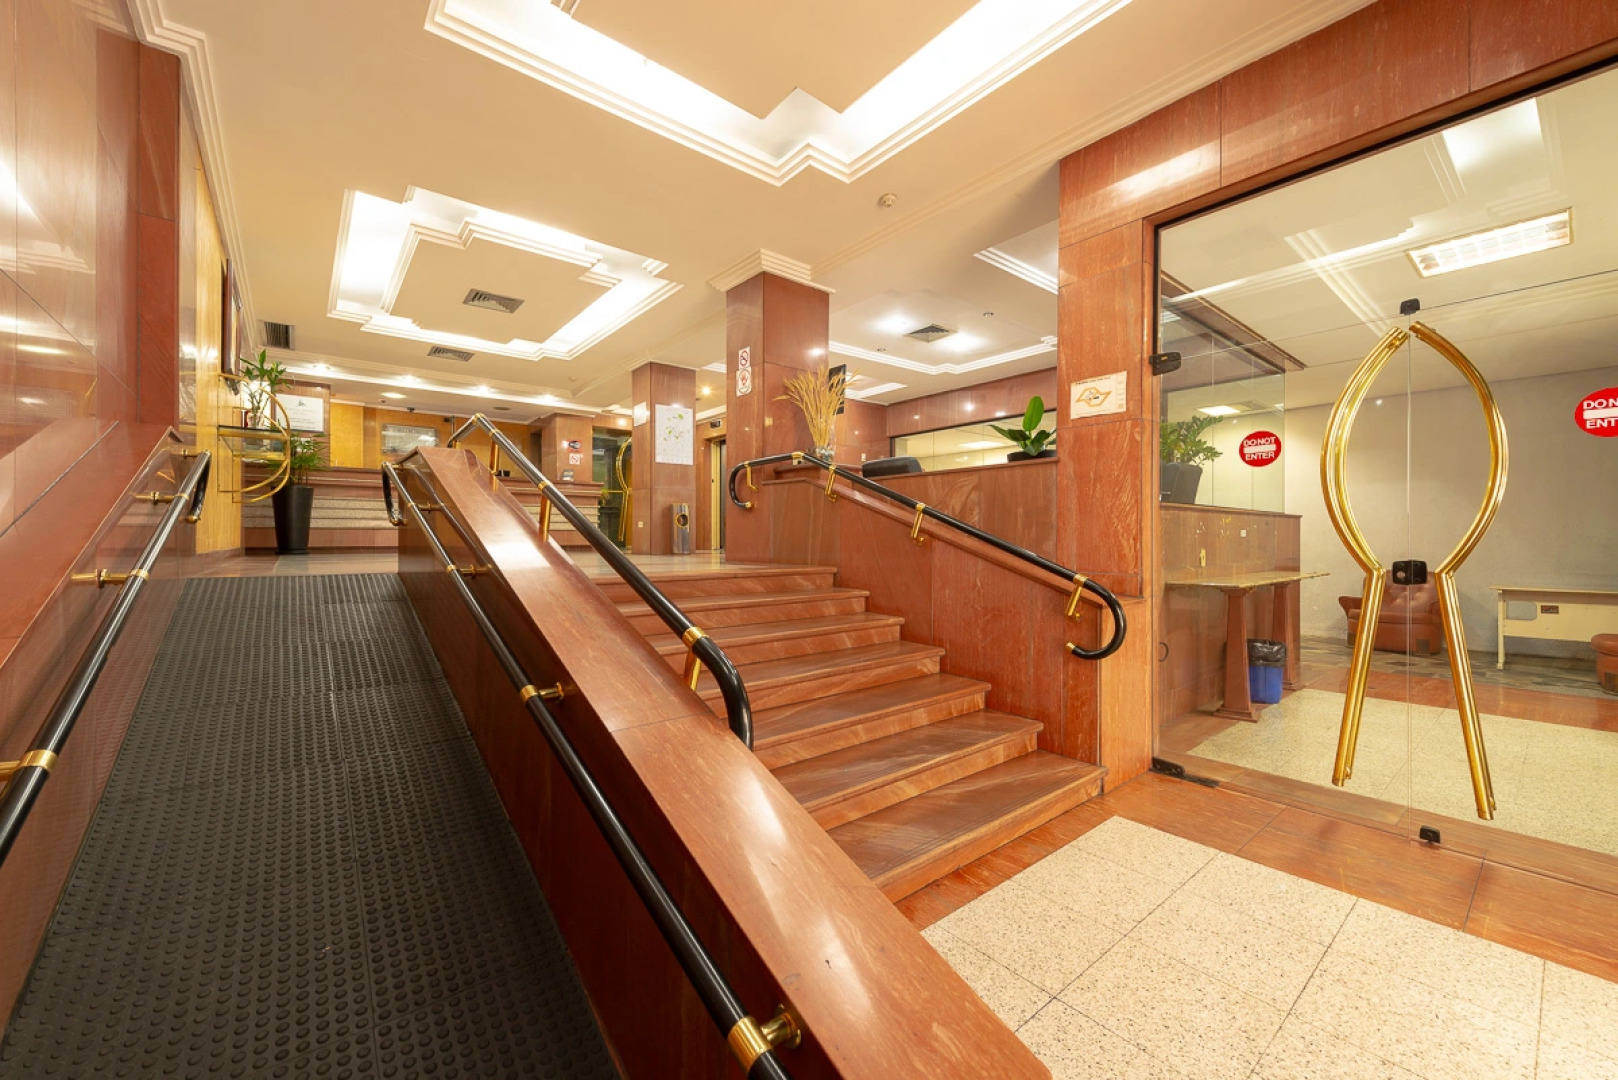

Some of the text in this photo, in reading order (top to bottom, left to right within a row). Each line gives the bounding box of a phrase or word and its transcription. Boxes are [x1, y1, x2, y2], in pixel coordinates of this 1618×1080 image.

[1583, 399, 1607, 409] DO
[1586, 418, 1618, 429] ENT
[1243, 437, 1276, 447] DO NOT
[1245, 452, 1275, 460] ENTER
